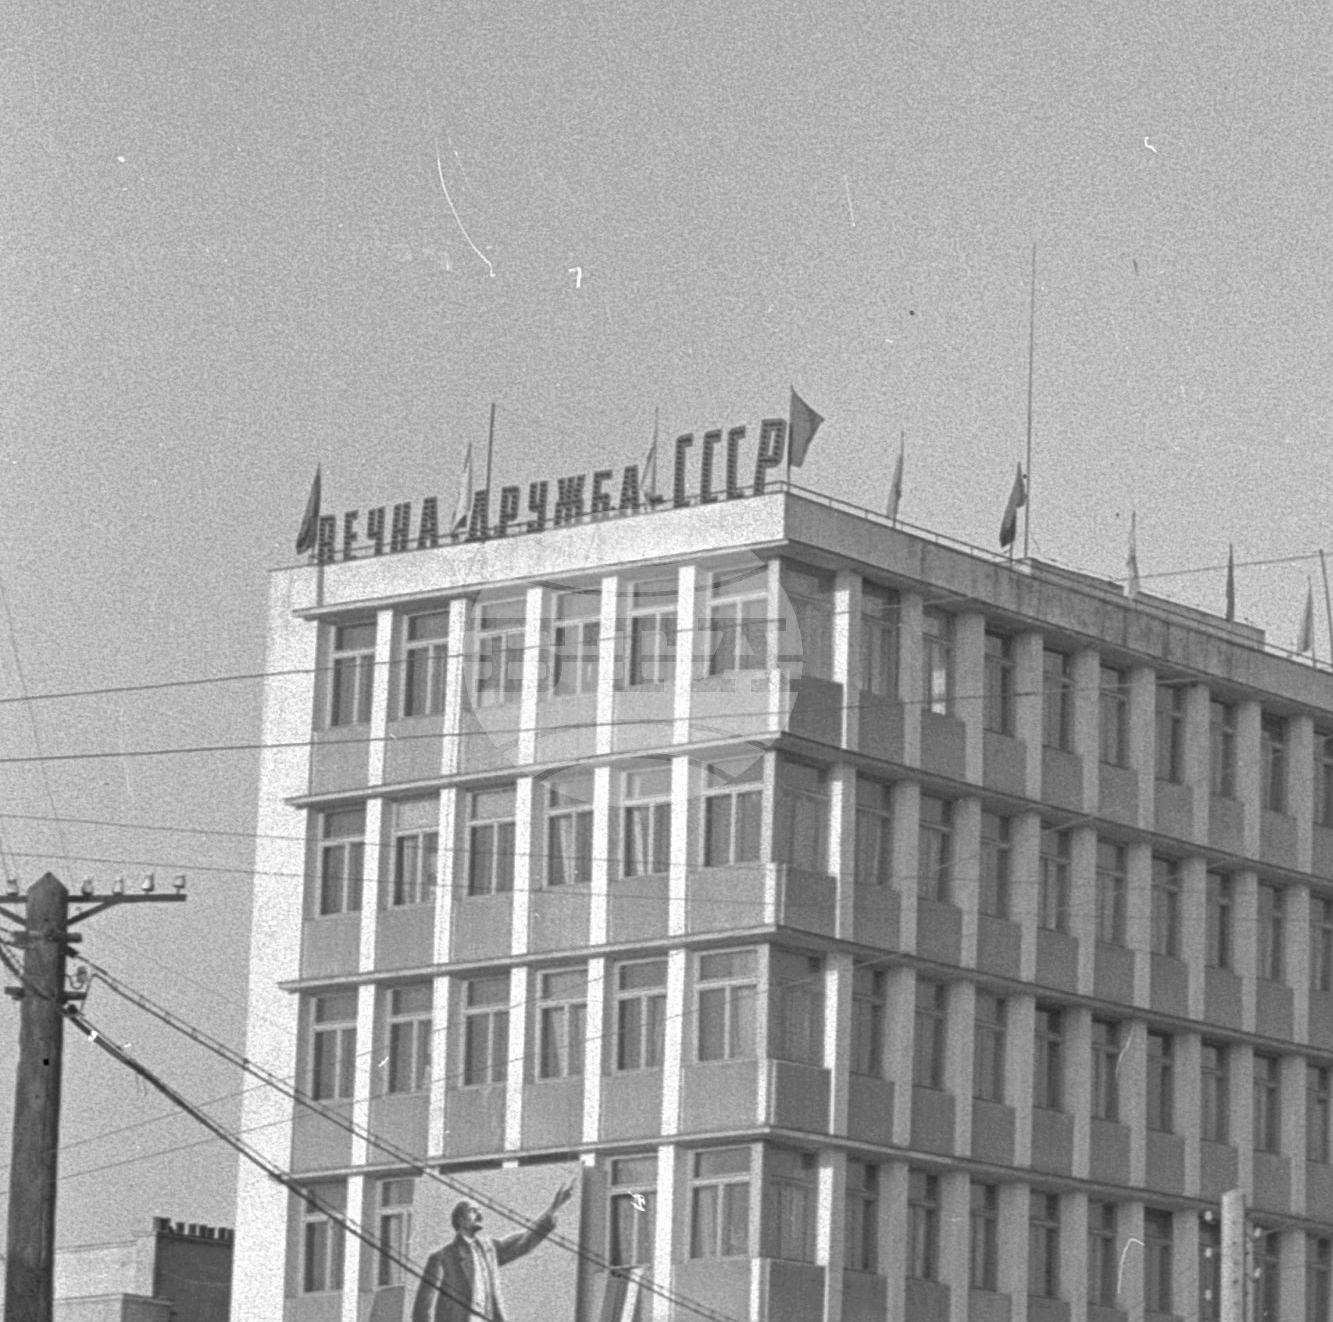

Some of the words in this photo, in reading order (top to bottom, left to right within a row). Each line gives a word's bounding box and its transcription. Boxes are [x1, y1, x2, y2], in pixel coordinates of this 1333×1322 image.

[319, 496, 438, 563] ВЕЧНА
[465, 464, 640, 543] ДРУЖБА
[674, 418, 787, 509] СССР
